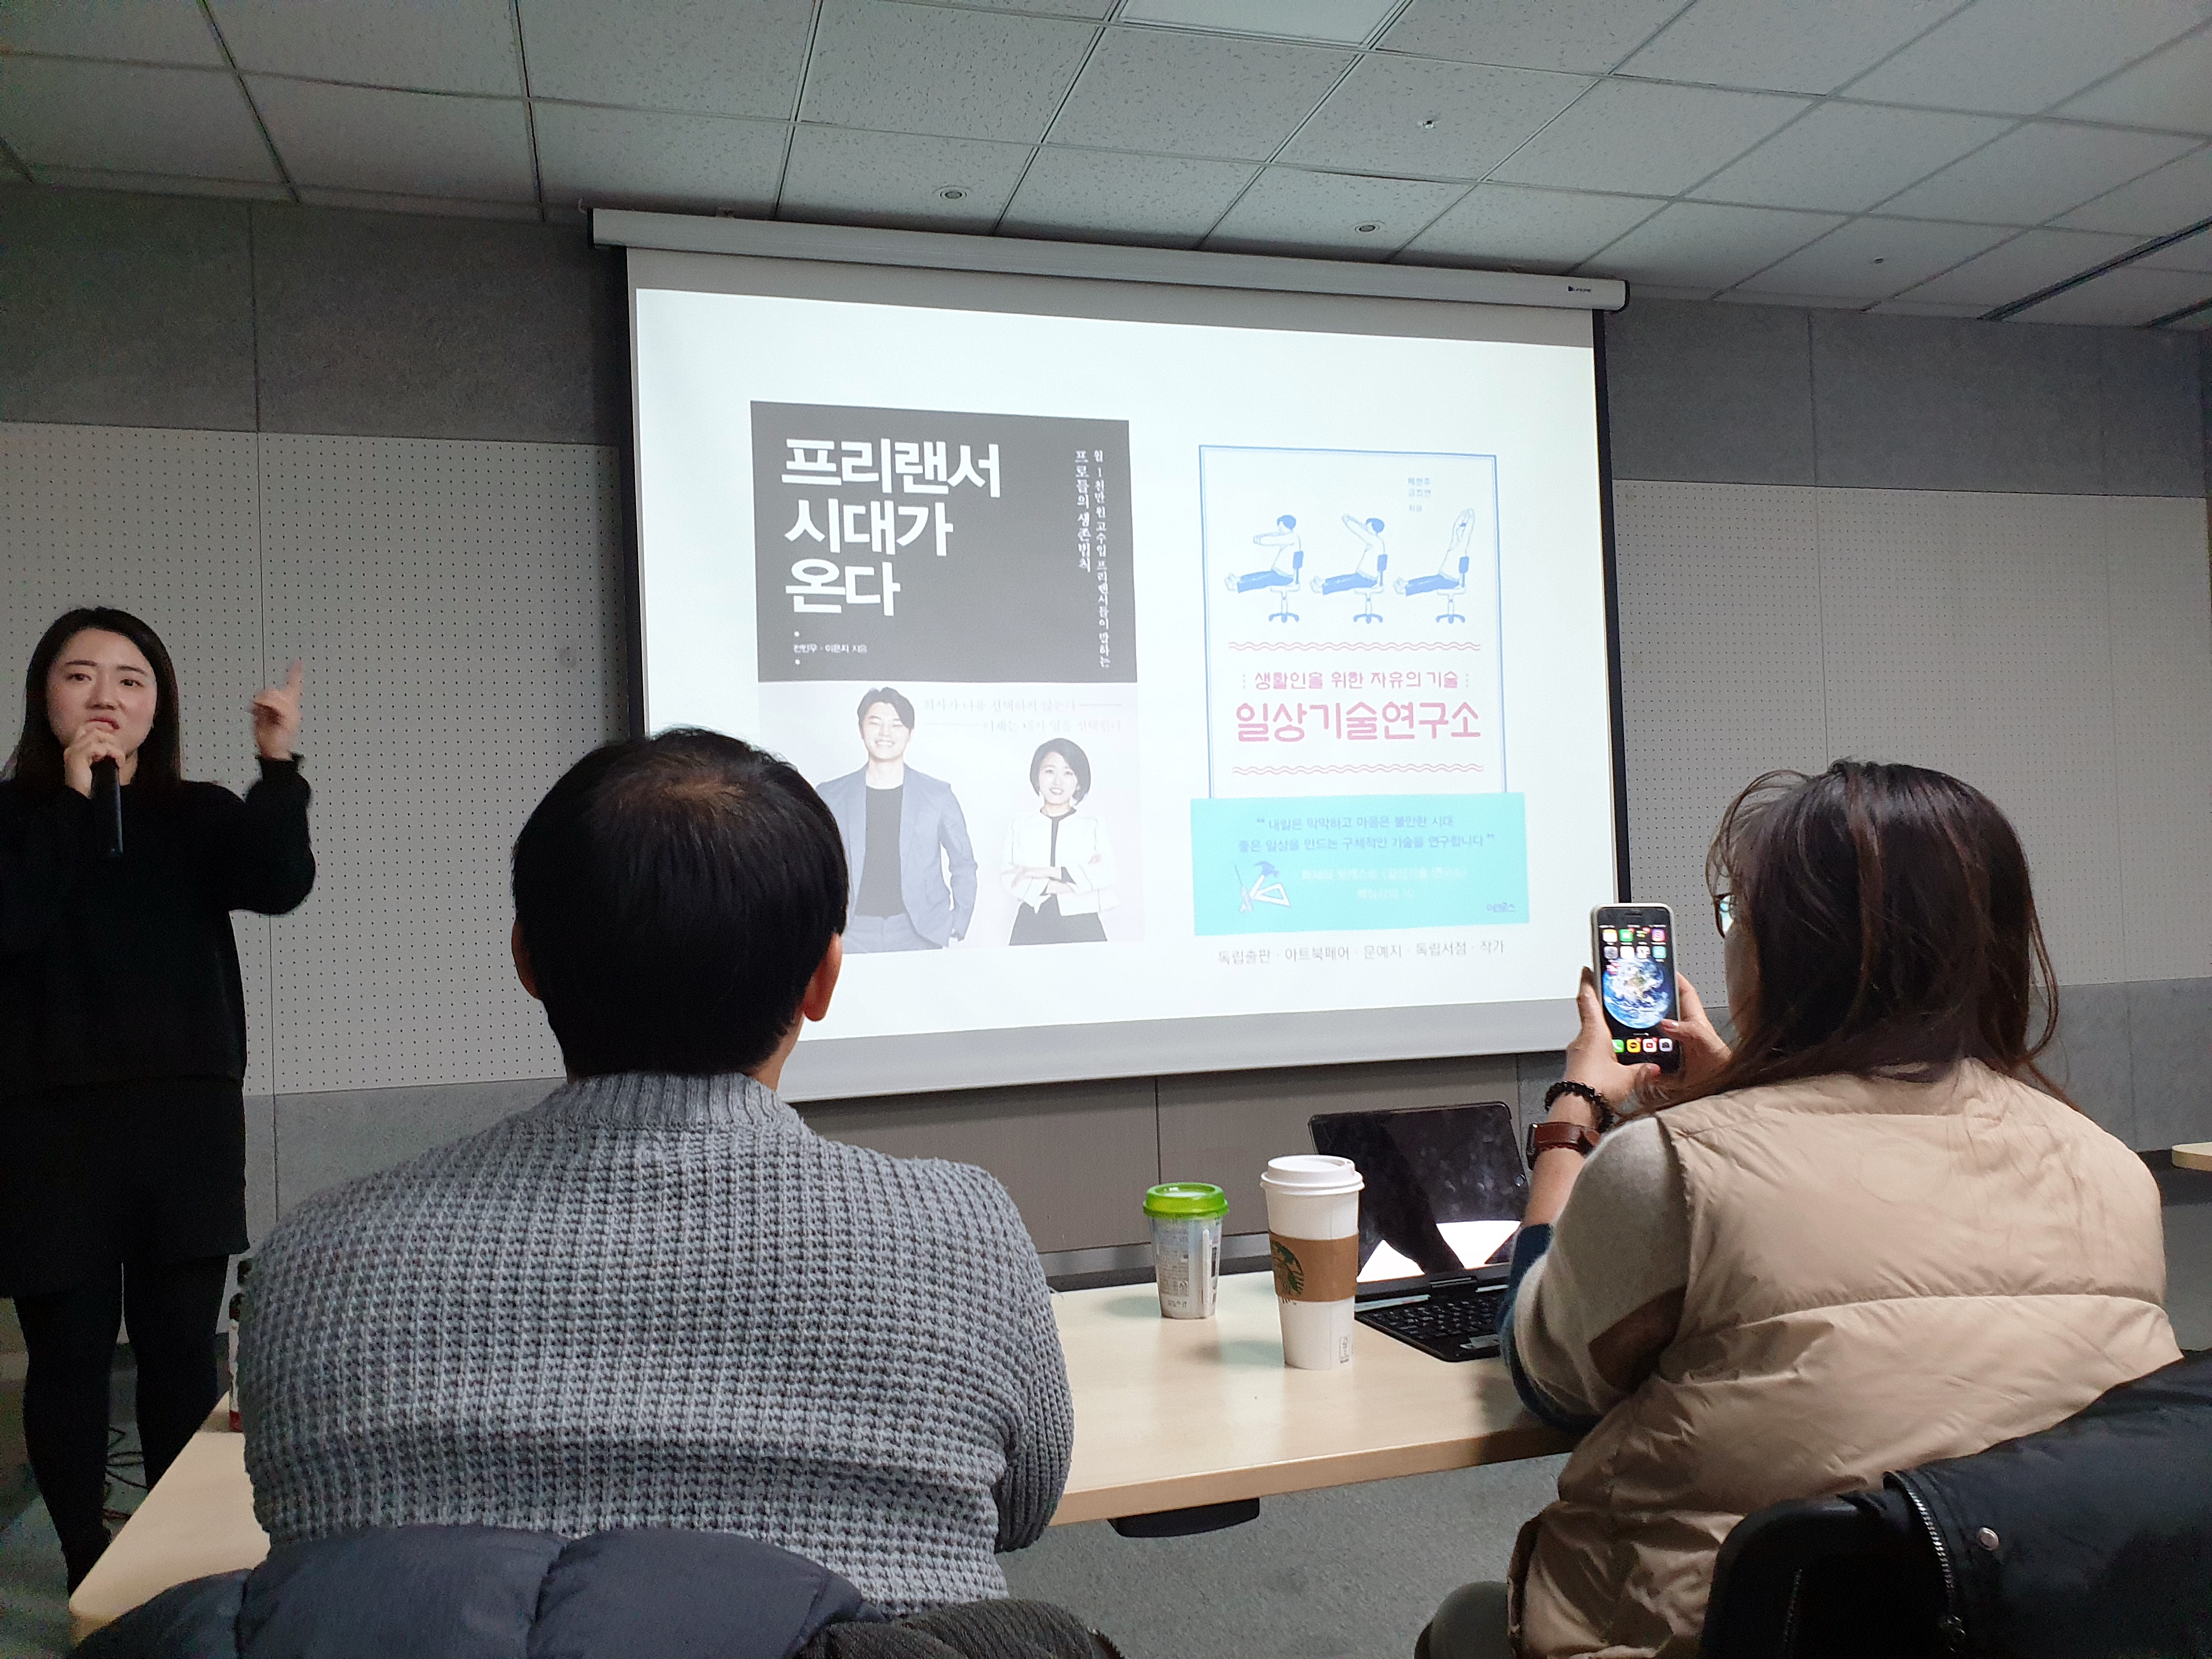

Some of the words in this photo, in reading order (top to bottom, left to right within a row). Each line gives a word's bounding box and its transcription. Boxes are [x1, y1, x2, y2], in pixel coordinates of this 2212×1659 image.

[781, 438, 1000, 498] 프리랜서
[784, 498, 954, 557] 시대가
[785, 558, 901, 617] 온다
[1255, 671, 1323, 690] 생활인을
[1331, 671, 1364, 690] 위한
[1370, 671, 1422, 689] 자유의
[1427, 670, 1458, 689] 기술
[1236, 700, 1481, 743] 일상기술연구소
[1218, 950, 1271, 965] 독립출판
[1284, 946, 1350, 962] 아트북페어
[1363, 943, 1402, 960] 문예지
[1415, 941, 1467, 957] 독립서점
[1479, 939, 1505, 955] 작가
